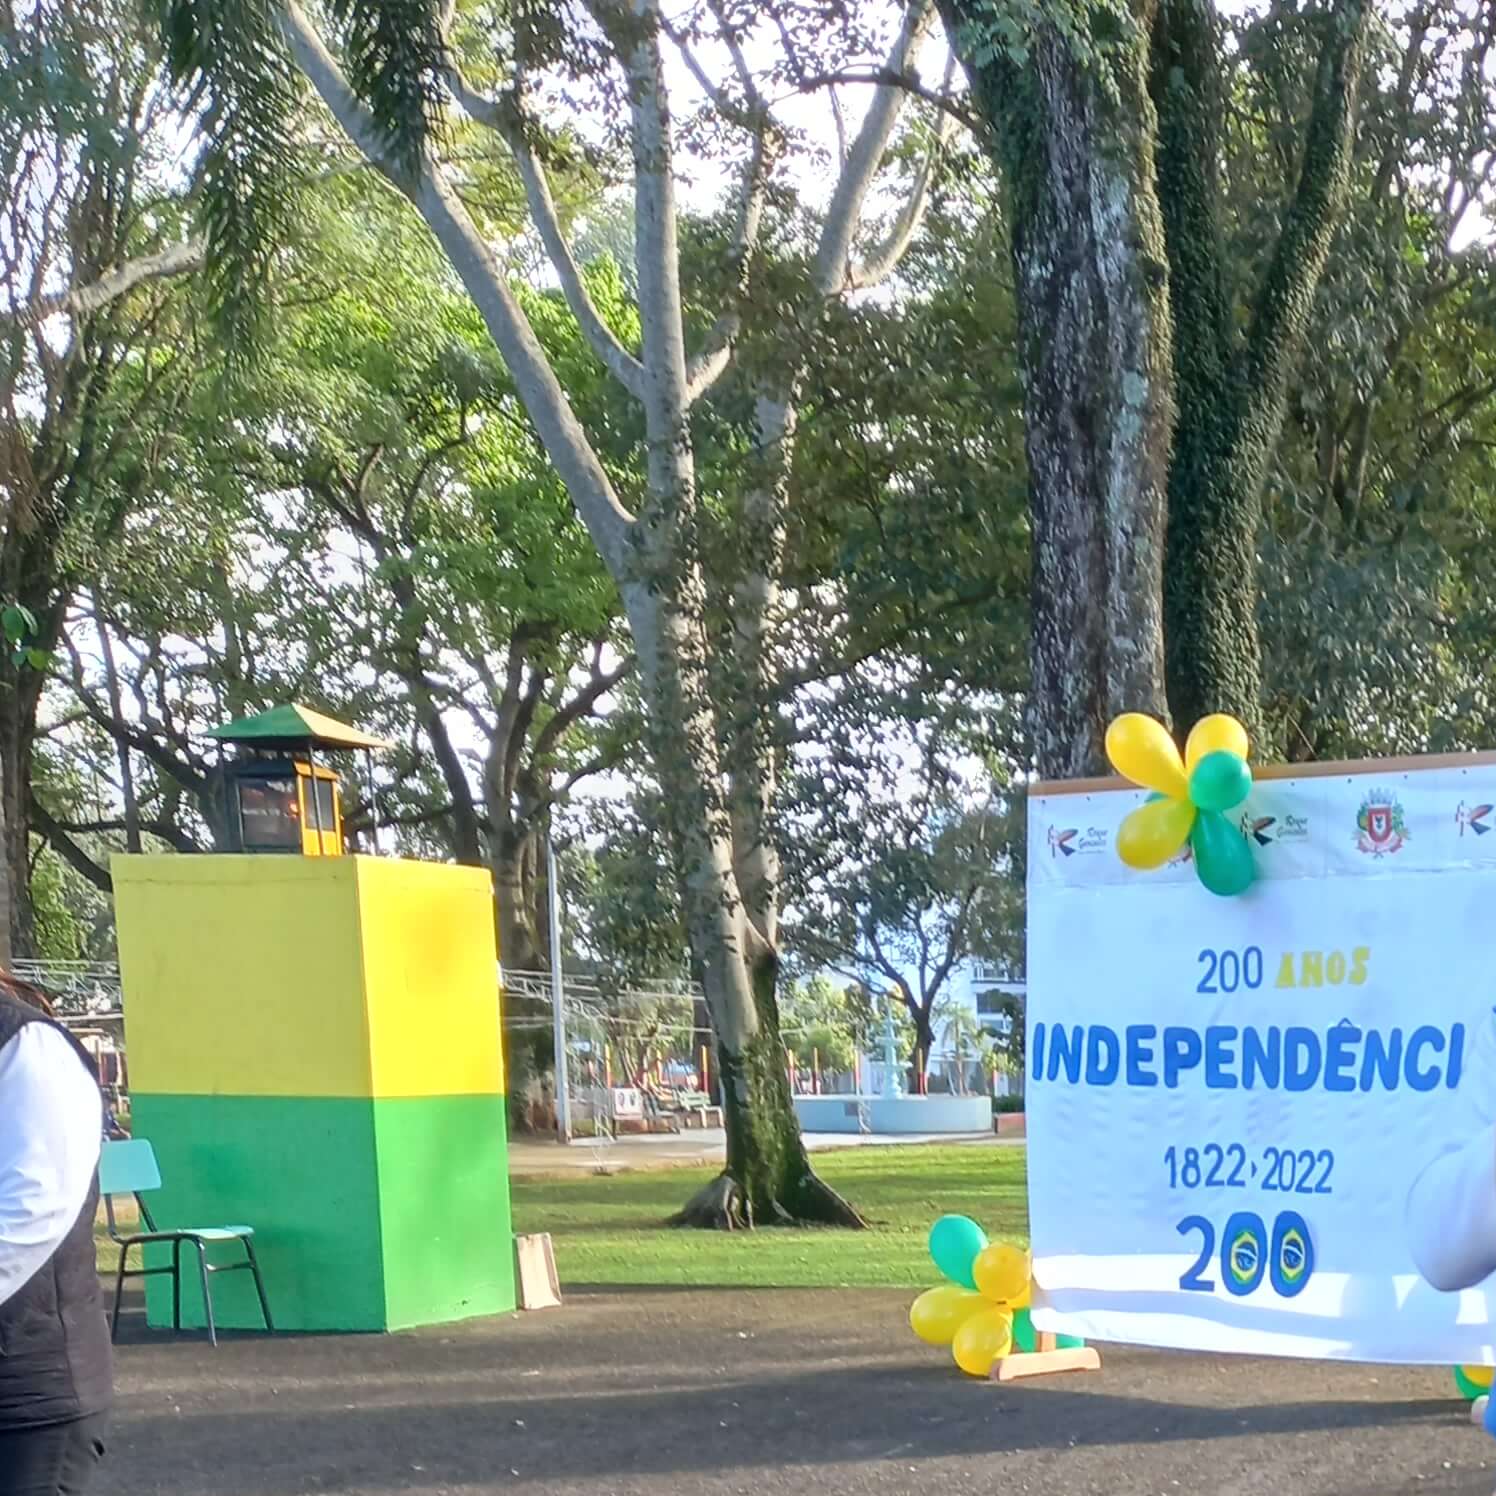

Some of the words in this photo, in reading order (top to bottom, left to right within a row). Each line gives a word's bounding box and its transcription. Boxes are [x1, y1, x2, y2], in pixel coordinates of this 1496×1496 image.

[1197, 945, 1263, 994] 200
[1275, 945, 1371, 988] ANOS
[1031, 1018, 1465, 1091] INDEPENDÊNCI
[1176, 1210, 1314, 1298] 200
